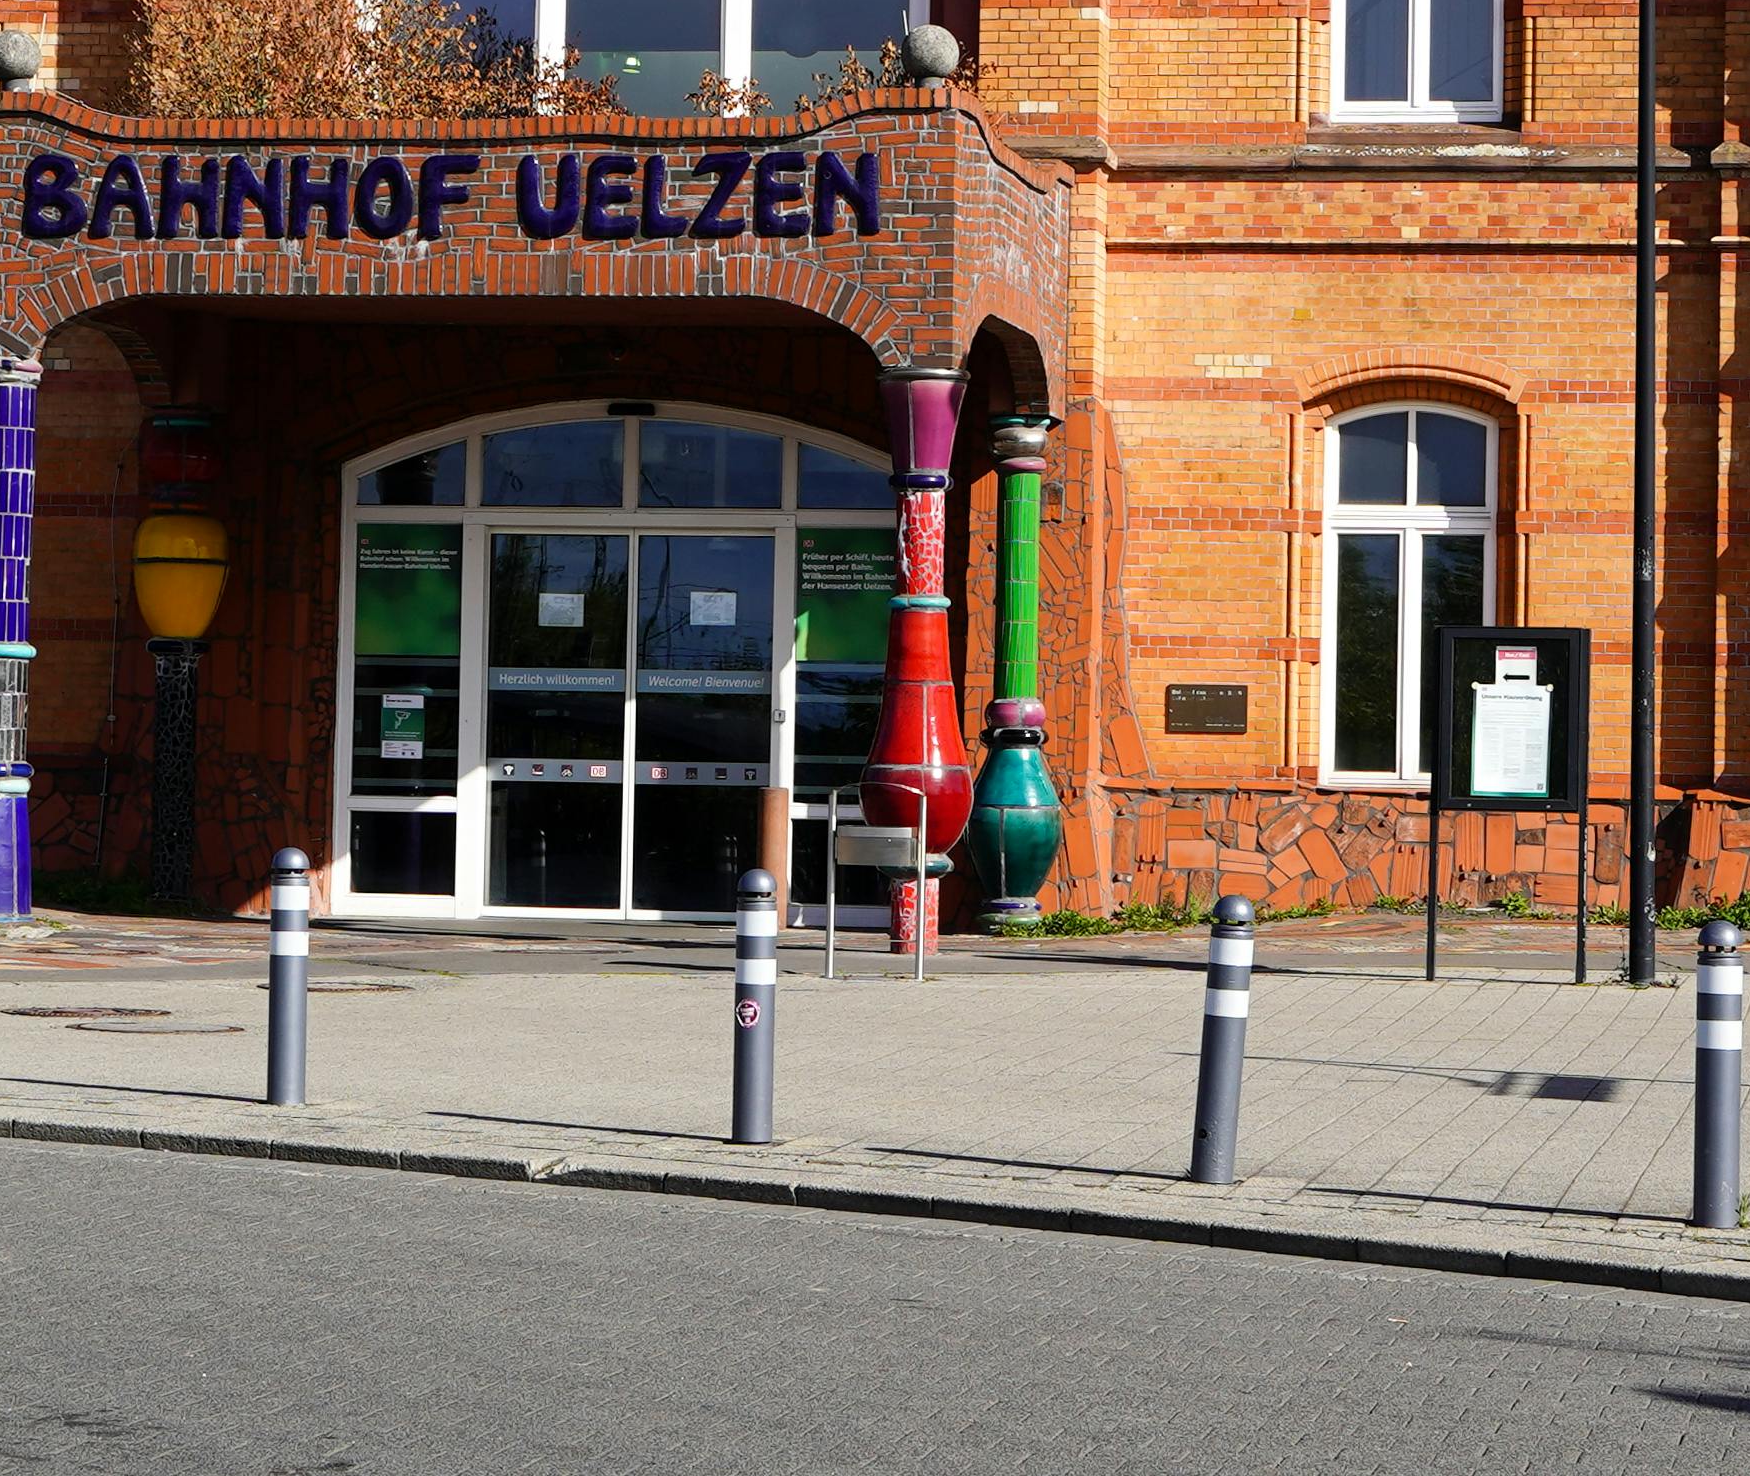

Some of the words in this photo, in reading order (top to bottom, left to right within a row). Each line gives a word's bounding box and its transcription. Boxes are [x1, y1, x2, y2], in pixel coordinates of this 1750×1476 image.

[22, 153, 482, 241] BAHNHOF
[516, 152, 882, 240] UELZEN
[830, 554, 843, 562] per
[802, 572, 851, 580] Willkommen
[802, 582, 815, 590] der
[499, 673, 543, 686] Herzlich
[546, 674, 615, 687] willkommen!
[648, 675, 702, 688] Welcome!
[705, 676, 765, 689] Bienvenue!
